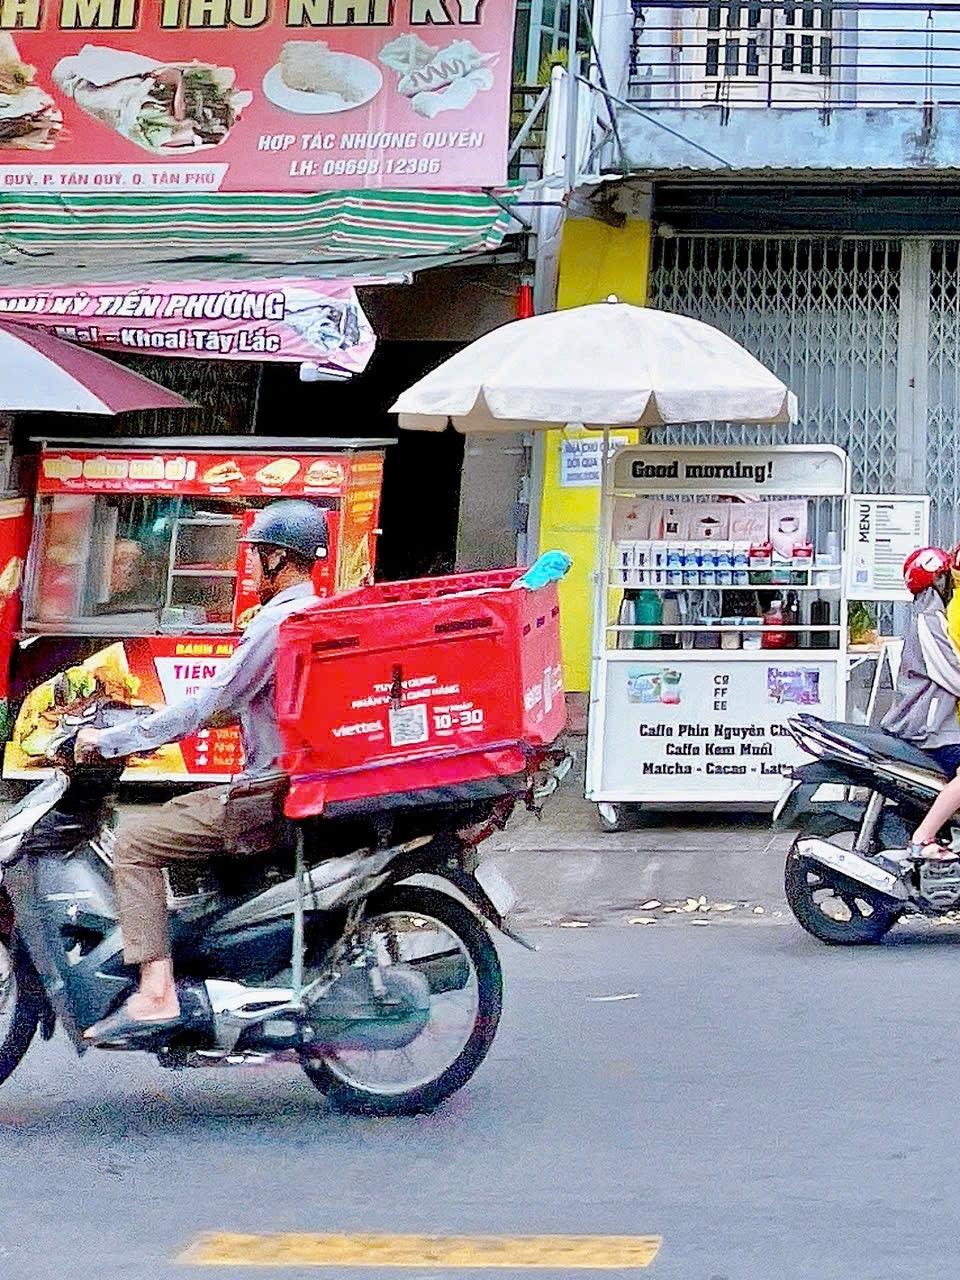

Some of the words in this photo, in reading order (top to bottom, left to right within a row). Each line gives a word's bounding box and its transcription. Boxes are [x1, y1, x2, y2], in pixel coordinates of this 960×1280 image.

[258, 132, 296, 154] HỢP
[301, 131, 335, 150] TÁC
[164, 290, 286, 321] PHƯƠNG
[193, 328, 236, 353] Tây
[238, 326, 281, 352] Lắc
[632, 460, 679, 478] Good
[685, 460, 774, 483] morning!
[859, 504, 871, 543] MENU
[678, 724, 709, 737] Phin
[705, 743, 735, 756] Kem
[642, 762, 692, 775] Matcha
[706, 763, 746, 775] Cacao
